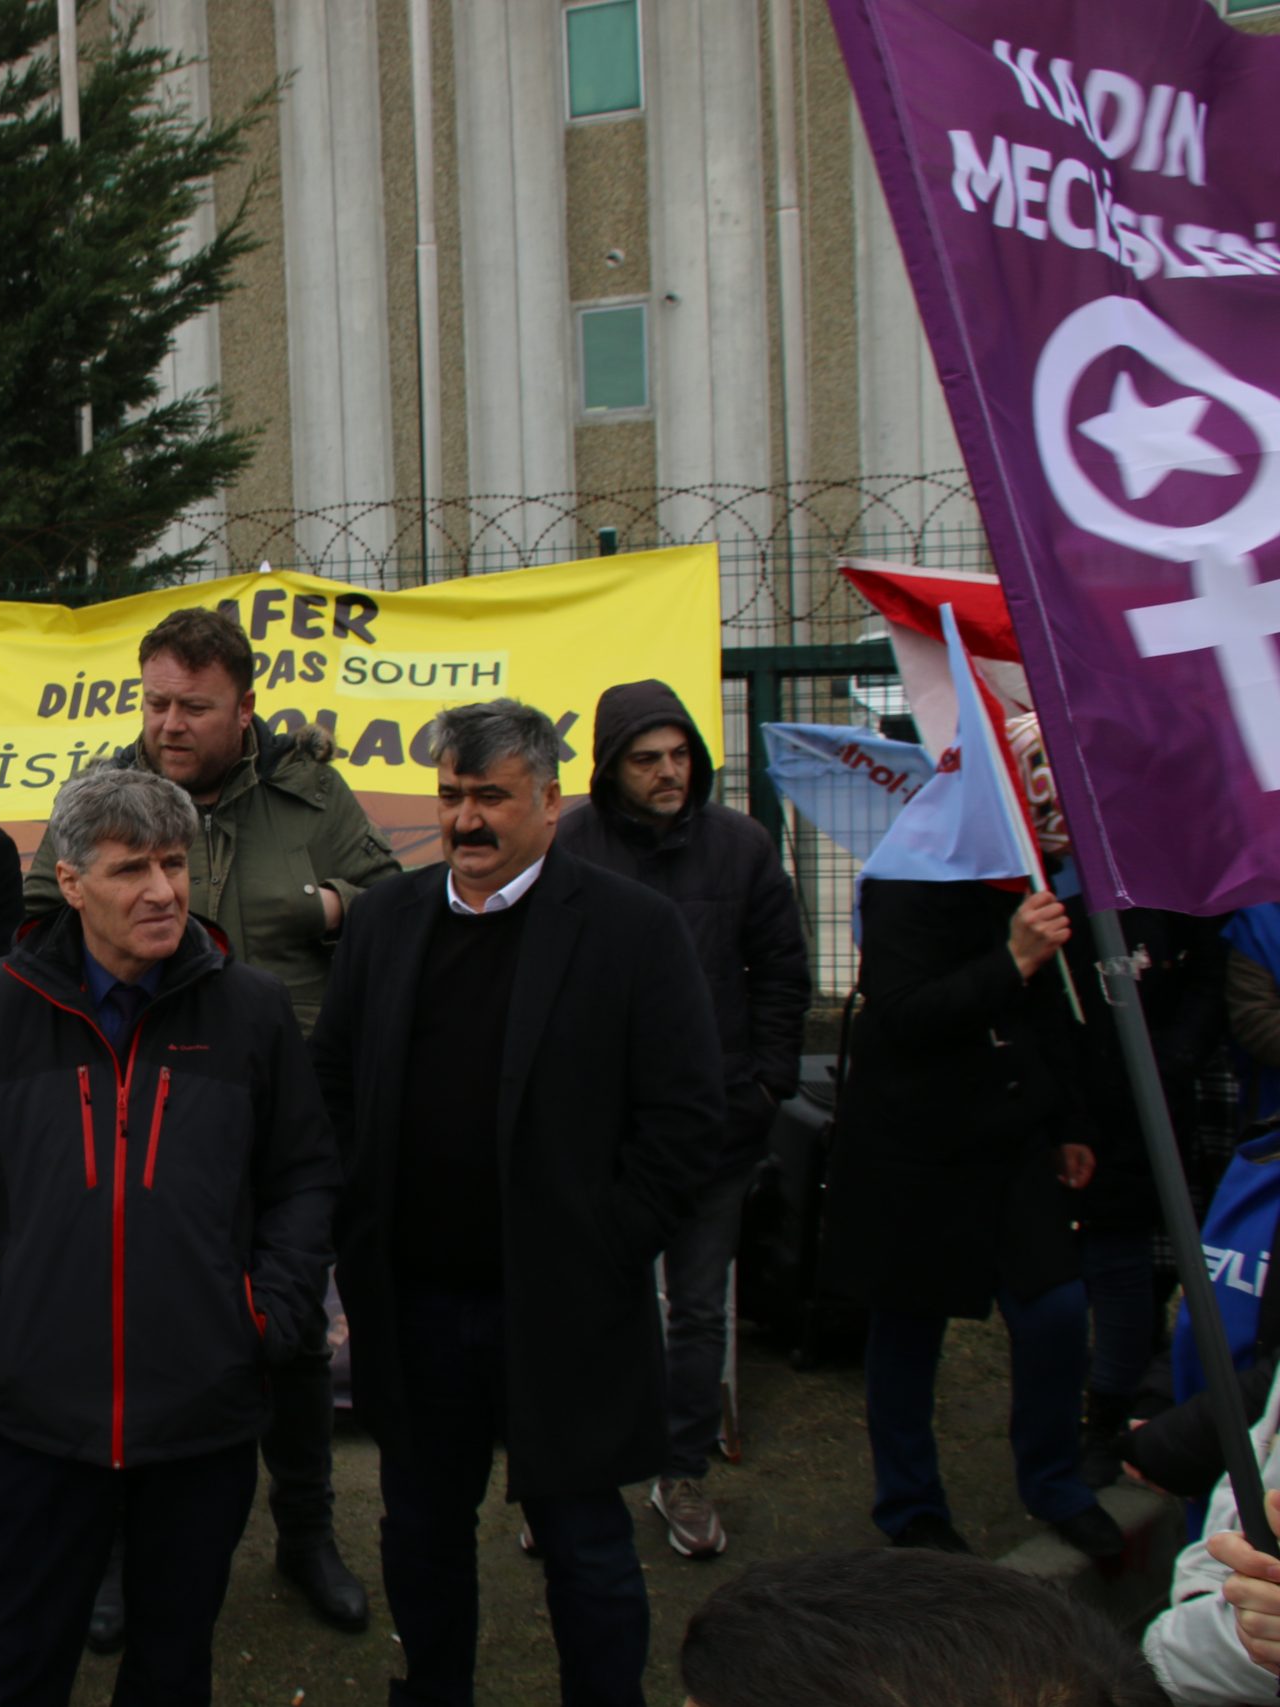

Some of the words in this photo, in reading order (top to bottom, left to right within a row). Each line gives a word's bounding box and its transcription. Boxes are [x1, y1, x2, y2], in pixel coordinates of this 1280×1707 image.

[993, 39, 1207, 187] KADIN
[37, 671, 144, 721] DİRE
[341, 655, 502, 688] SOUTH
